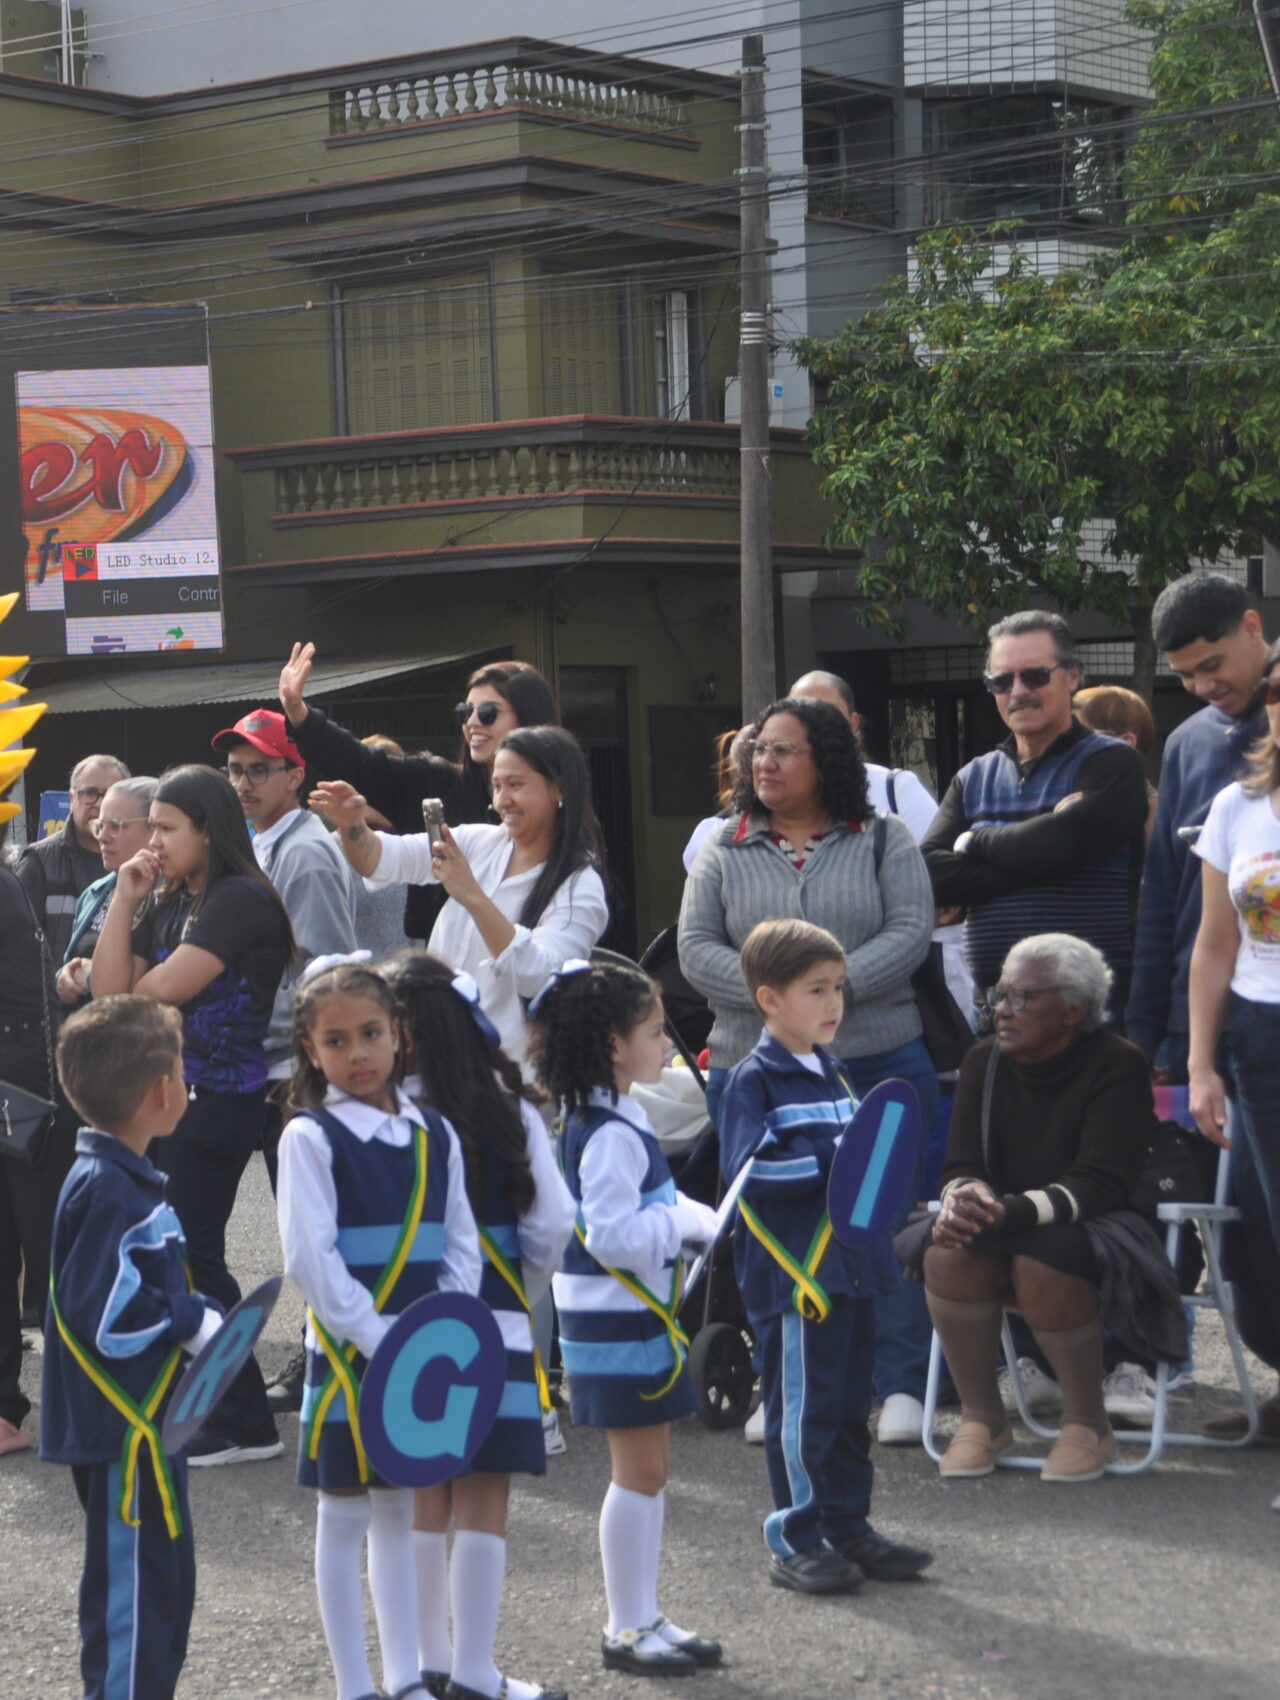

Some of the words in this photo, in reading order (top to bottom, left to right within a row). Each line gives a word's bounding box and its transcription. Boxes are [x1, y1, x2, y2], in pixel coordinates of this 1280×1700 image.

[65, 546, 95, 560] LED
[107, 554, 131, 568] LED
[139, 552, 187, 567] Studio
[195, 551, 215, 564] 12.
[102, 588, 128, 605] File
[178, 586, 219, 601] Contr
[173, 1305, 264, 1424] R
[382, 1318, 481, 1459] G
